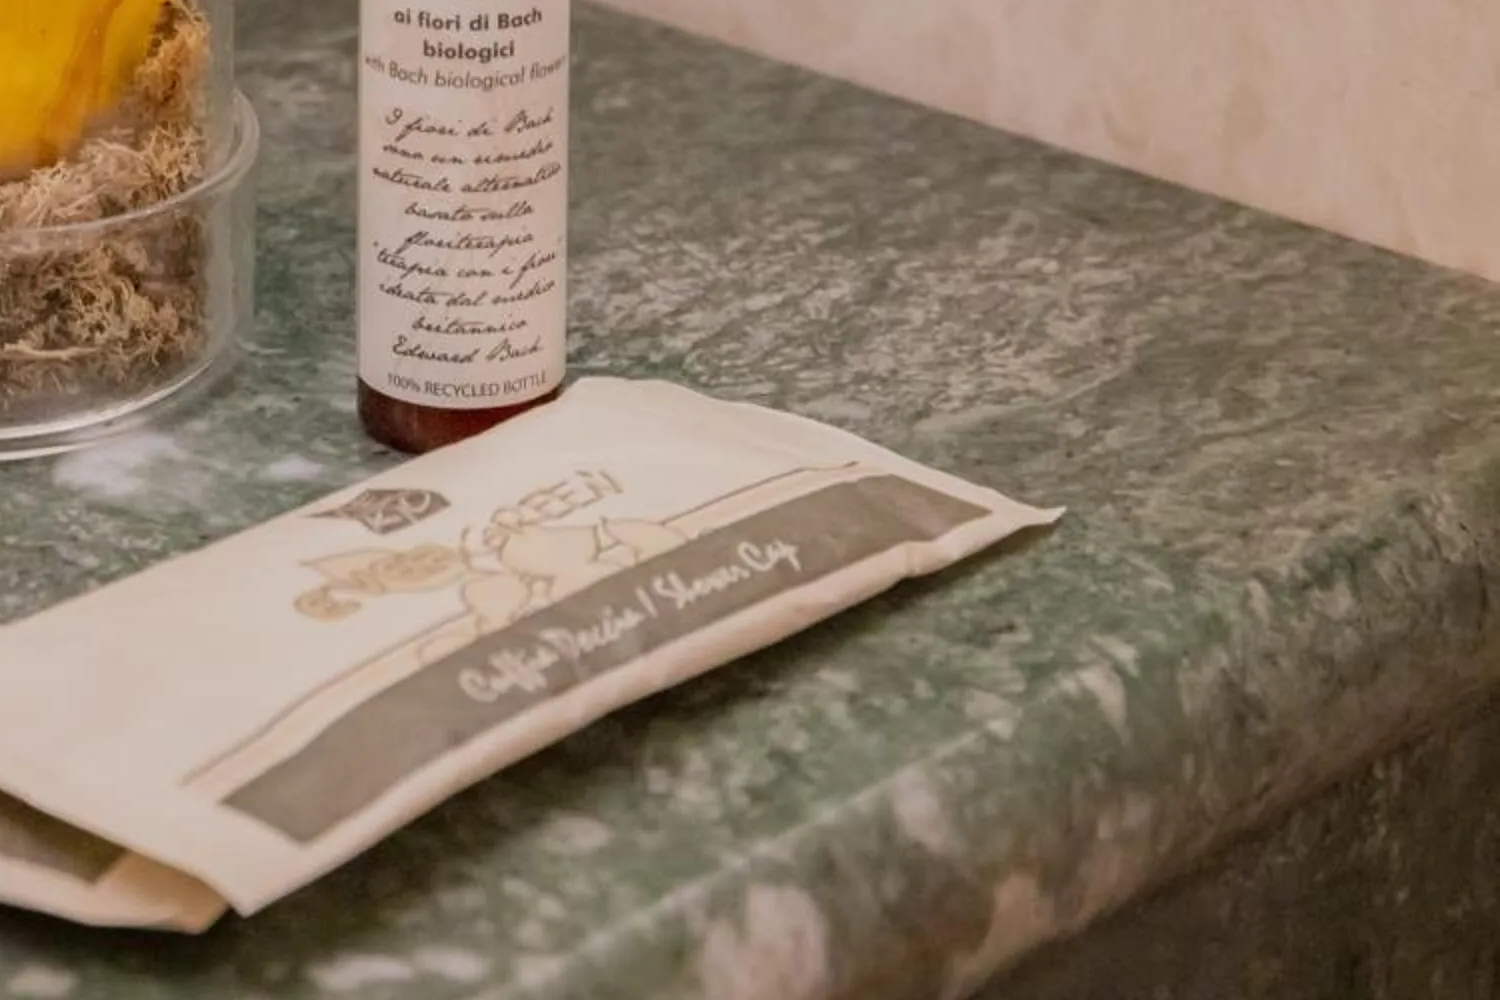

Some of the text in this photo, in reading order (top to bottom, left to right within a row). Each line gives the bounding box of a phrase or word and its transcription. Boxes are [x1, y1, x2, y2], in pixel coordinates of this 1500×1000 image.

[394, 8, 543, 32] ai fiori di Bach
[423, 40, 515, 64] biologici
[389, 61, 428, 85] Bach
[435, 67, 525, 92] biological
[467, 117, 493, 136] di
[504, 106, 555, 135] Bach
[372, 167, 454, 193] naturale
[486, 336, 545, 363] Bach
[387, 371, 549, 399] 100% RECYCLED BOTTLE
